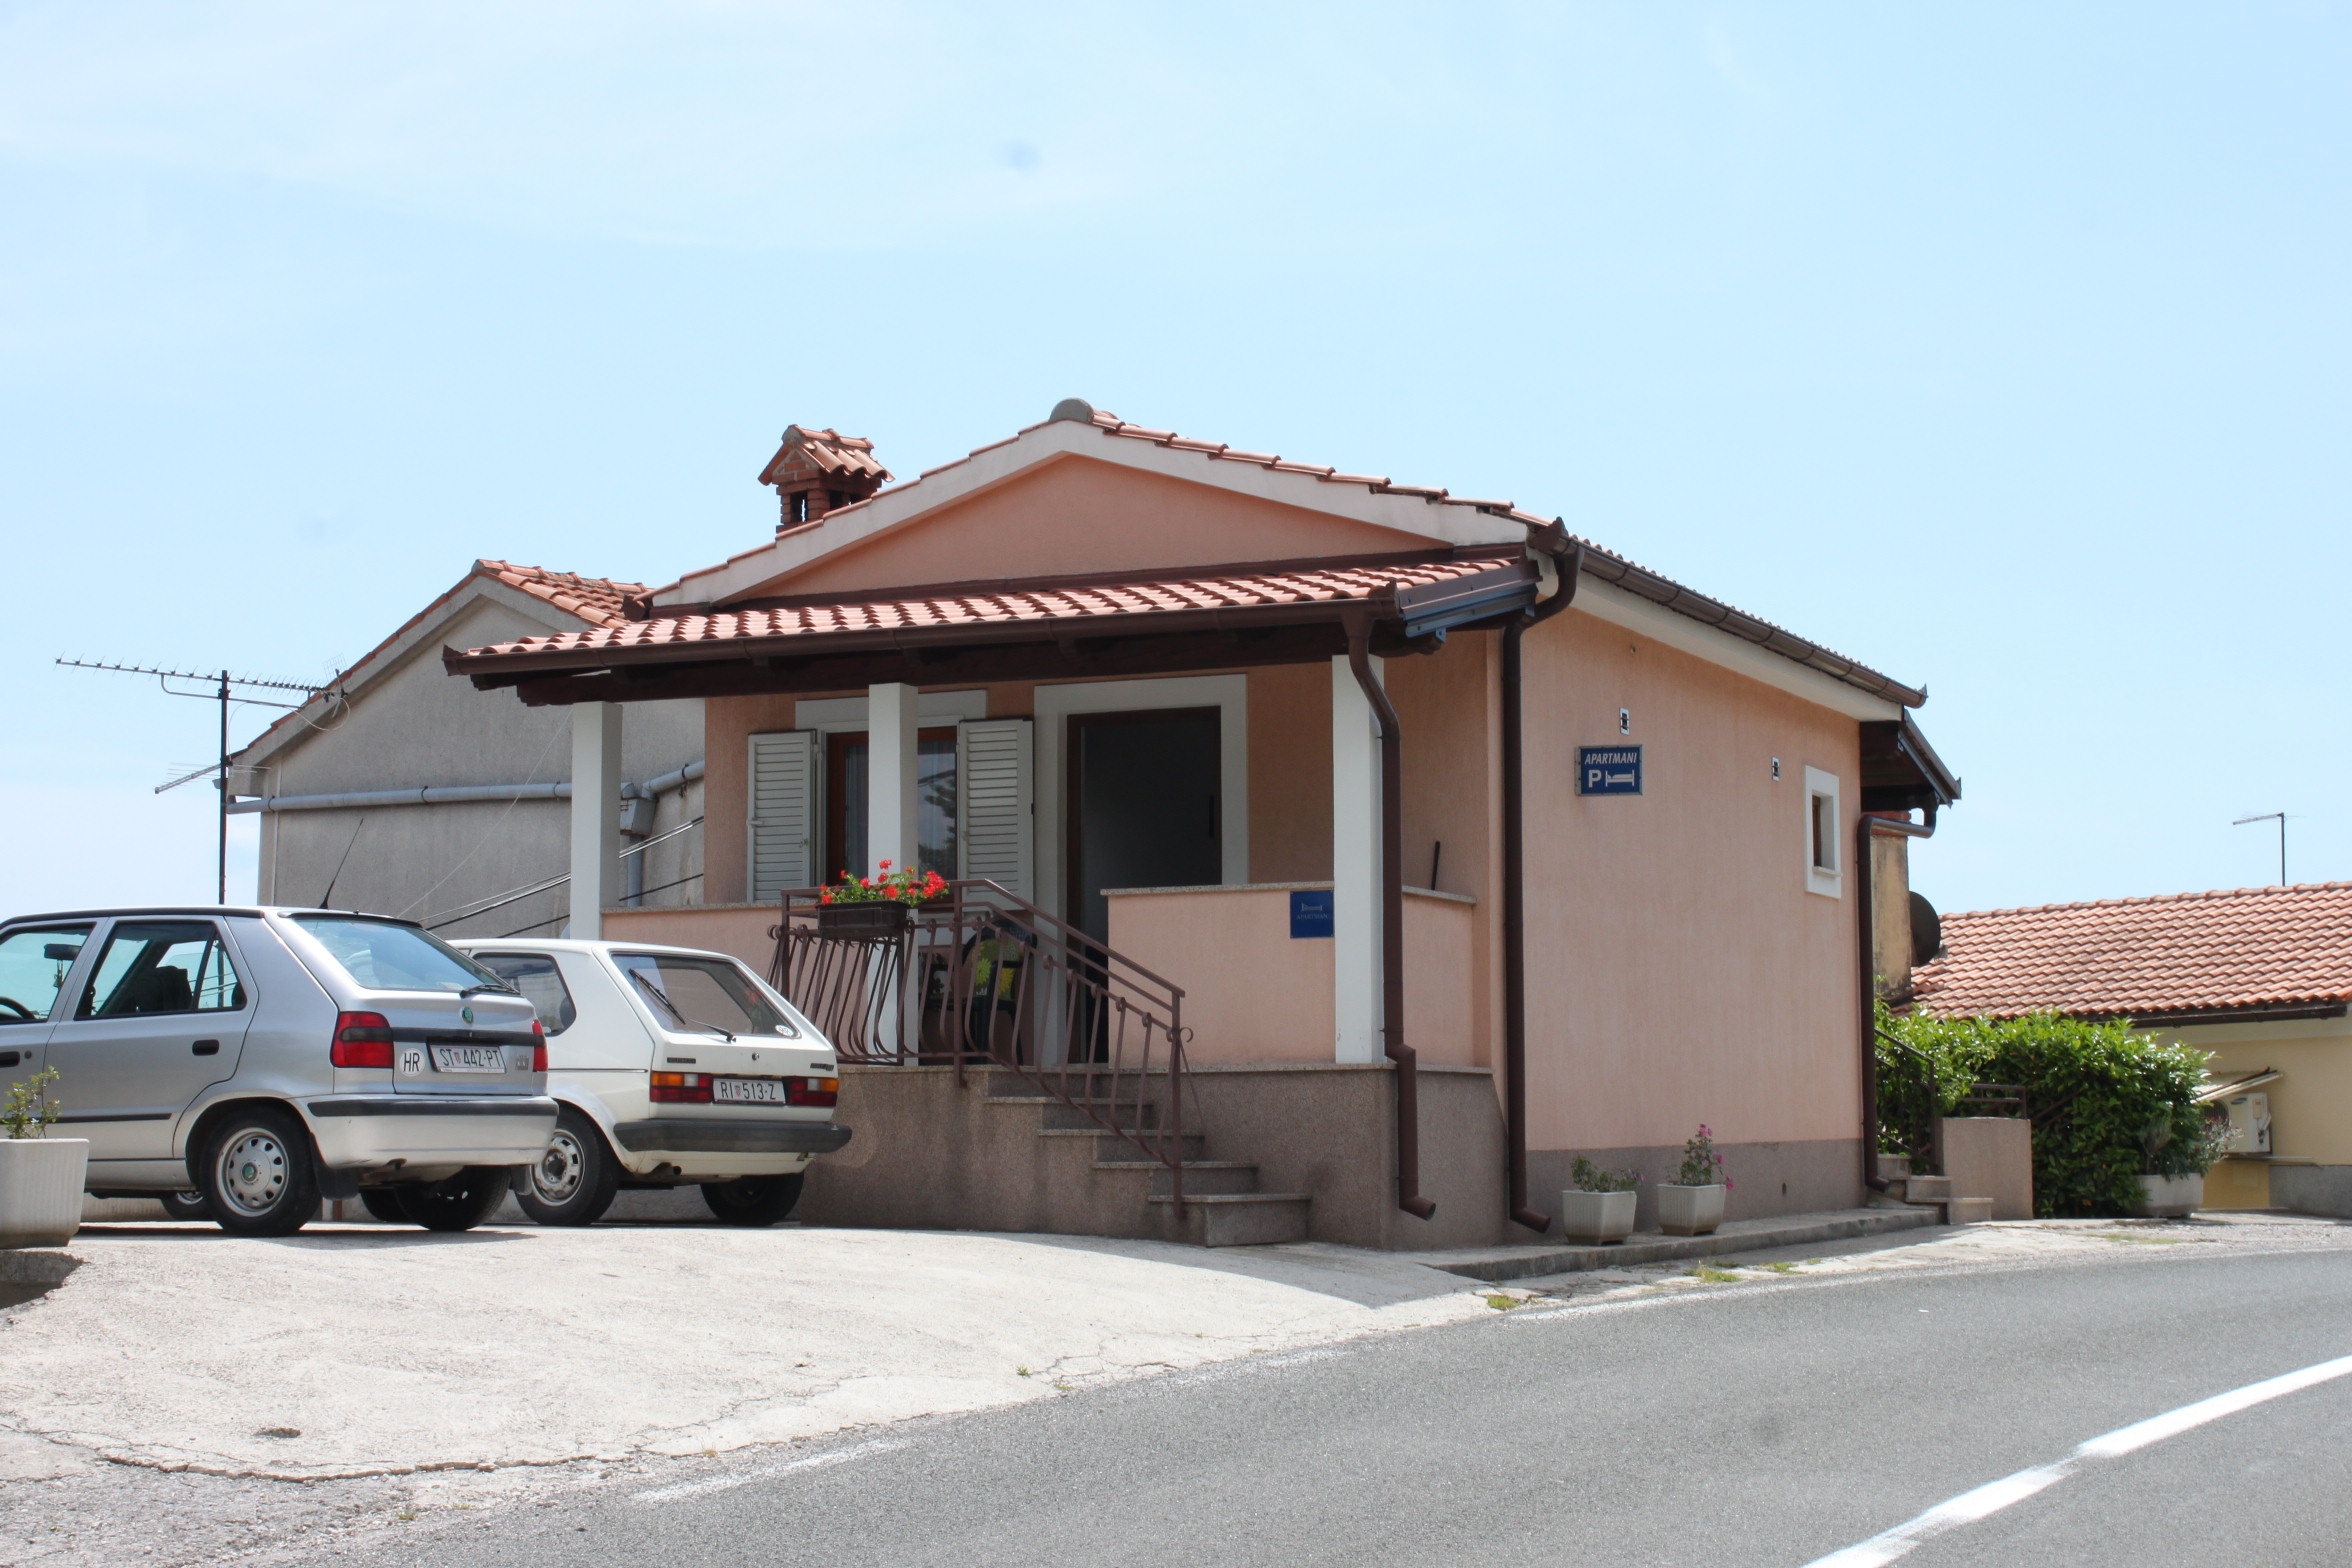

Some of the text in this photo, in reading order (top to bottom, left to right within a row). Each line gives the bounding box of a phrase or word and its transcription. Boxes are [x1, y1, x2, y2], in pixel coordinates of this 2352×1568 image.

[1584, 752, 1637, 765] APARTMANI
[1588, 769, 1602, 788] P
[403, 1052, 421, 1072] HR
[439, 1048, 455, 1067] ST
[720, 1081, 734, 1098] RI
